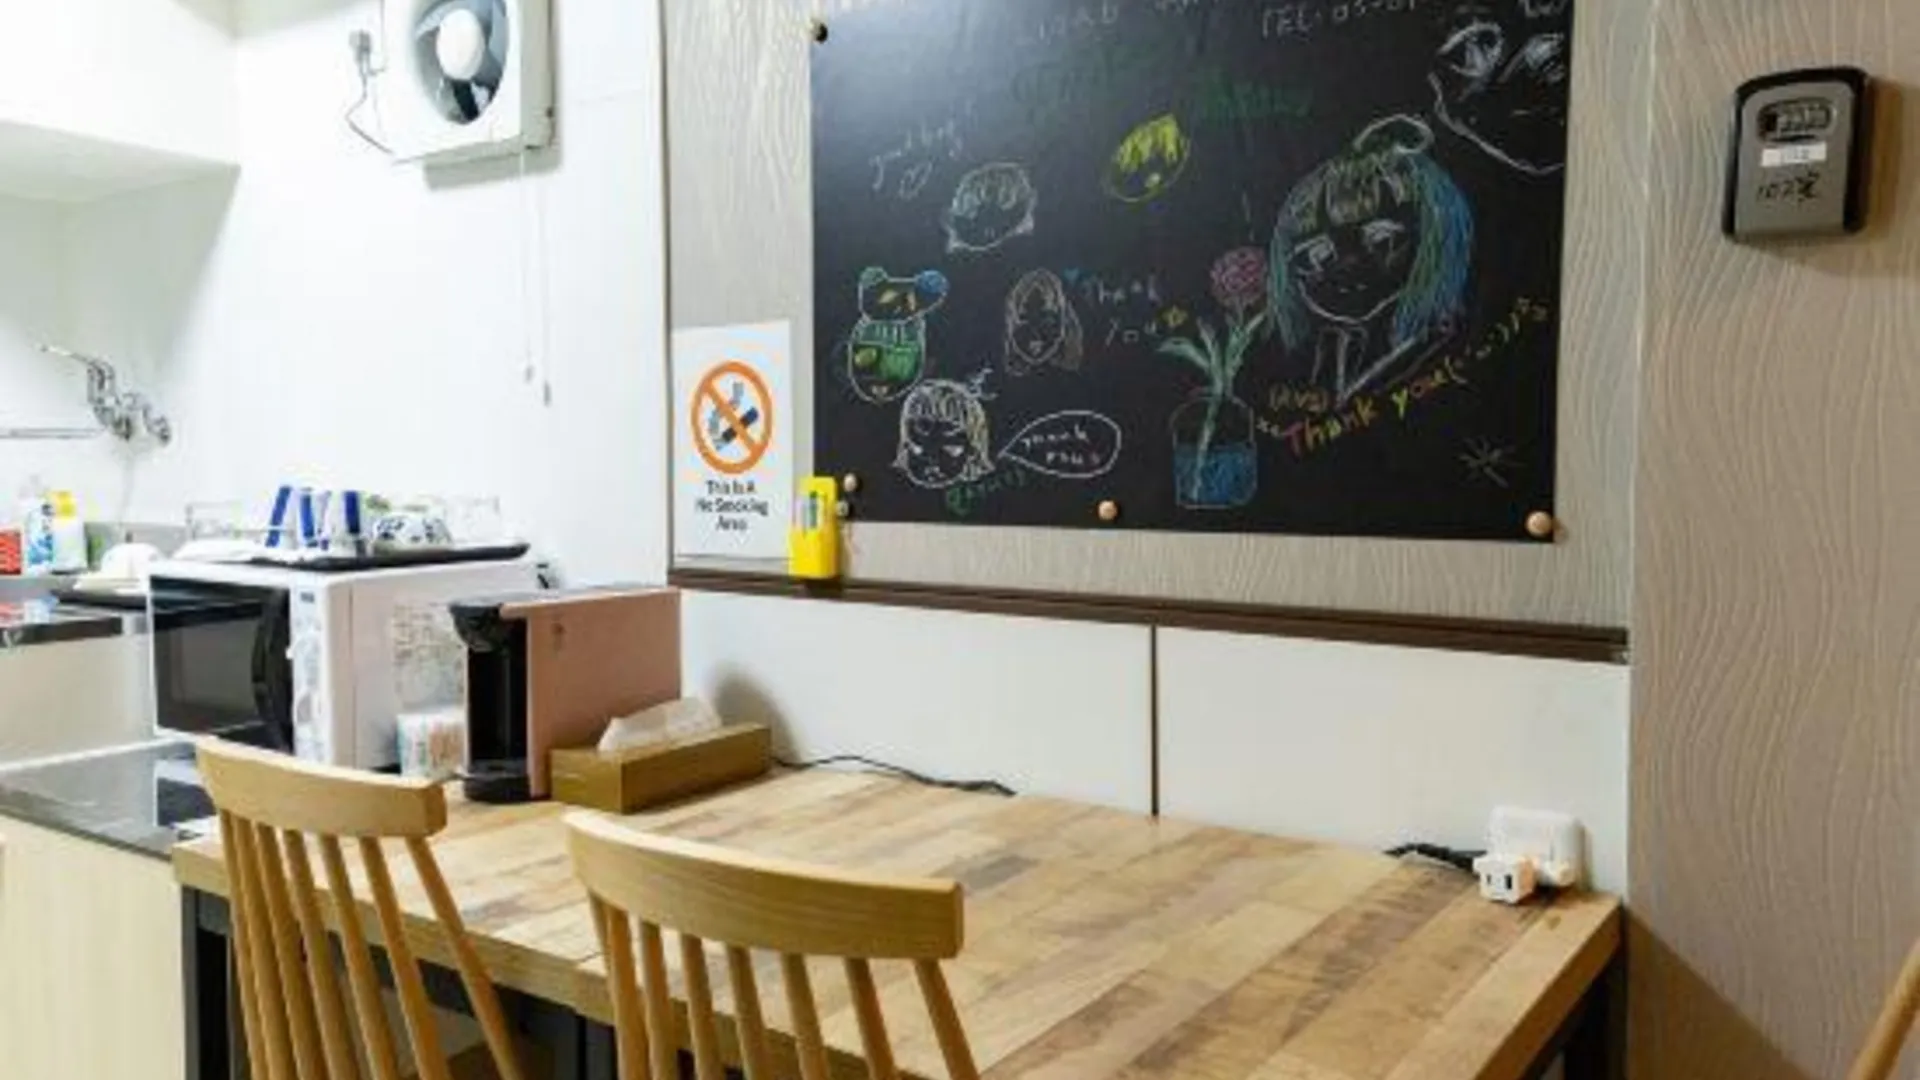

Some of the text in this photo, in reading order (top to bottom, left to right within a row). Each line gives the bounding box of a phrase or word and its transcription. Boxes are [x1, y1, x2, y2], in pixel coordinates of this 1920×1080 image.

[705, 479, 730, 495] This
[697, 497, 769, 517] No Smoking
[715, 515, 748, 532] Area
